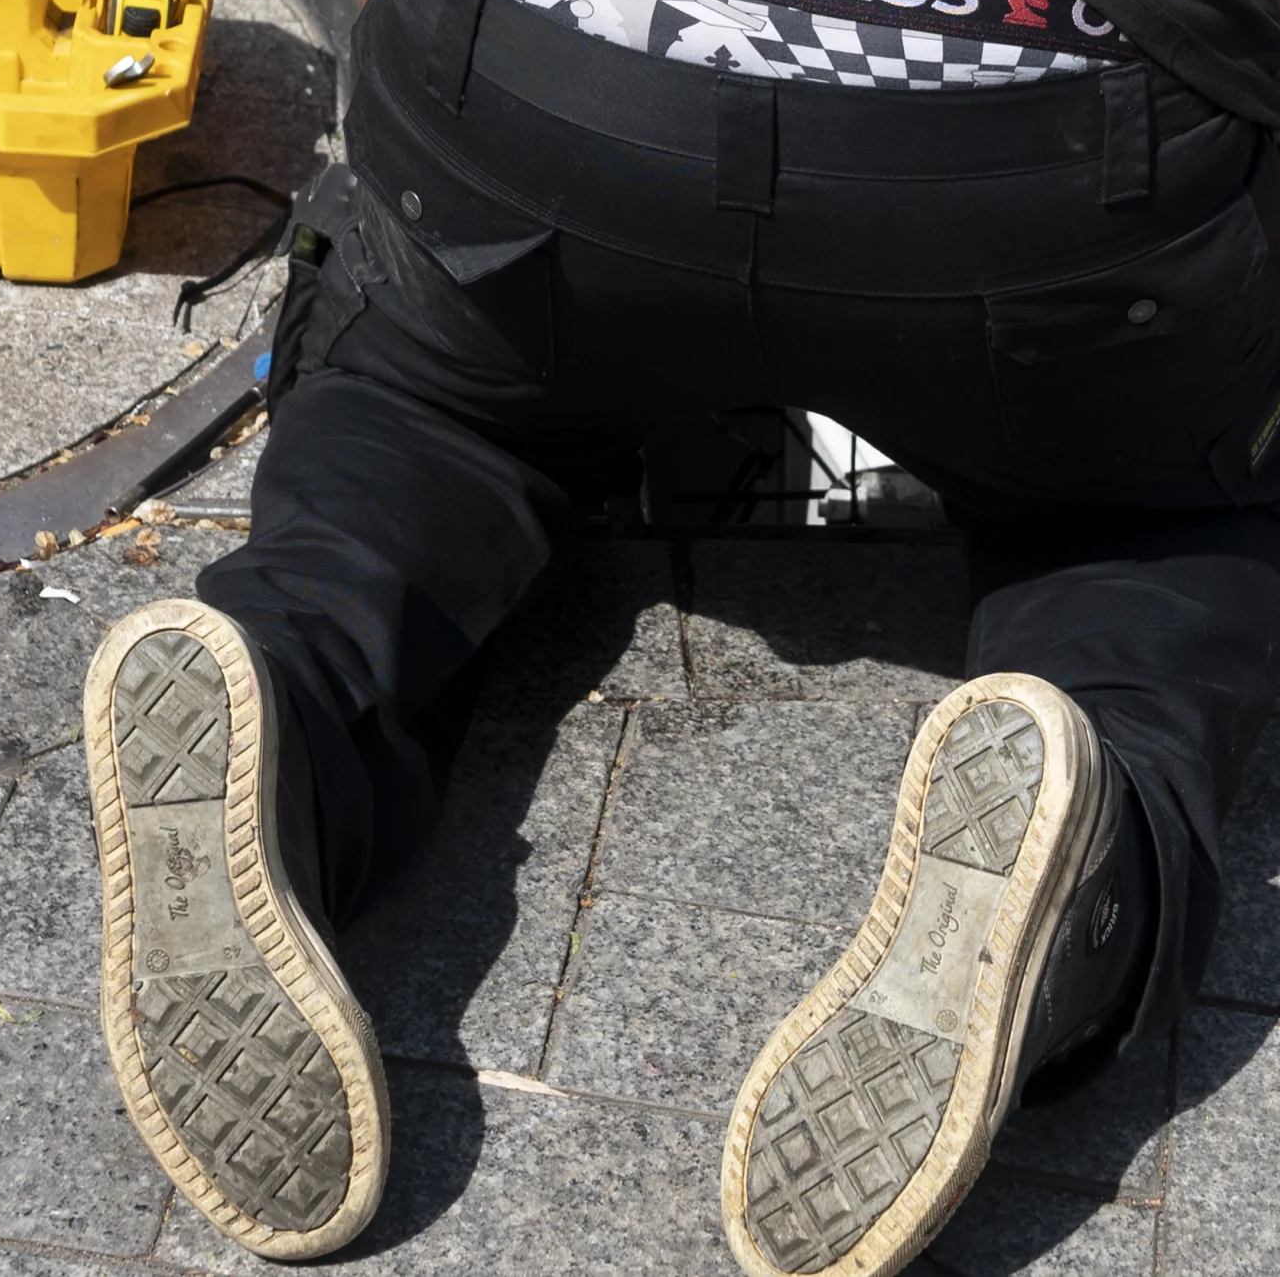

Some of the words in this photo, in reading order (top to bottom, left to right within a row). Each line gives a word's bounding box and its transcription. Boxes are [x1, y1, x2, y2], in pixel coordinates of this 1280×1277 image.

[167, 894, 189, 921] The
[927, 881, 960, 948] Original
[920, 950, 942, 976] The
